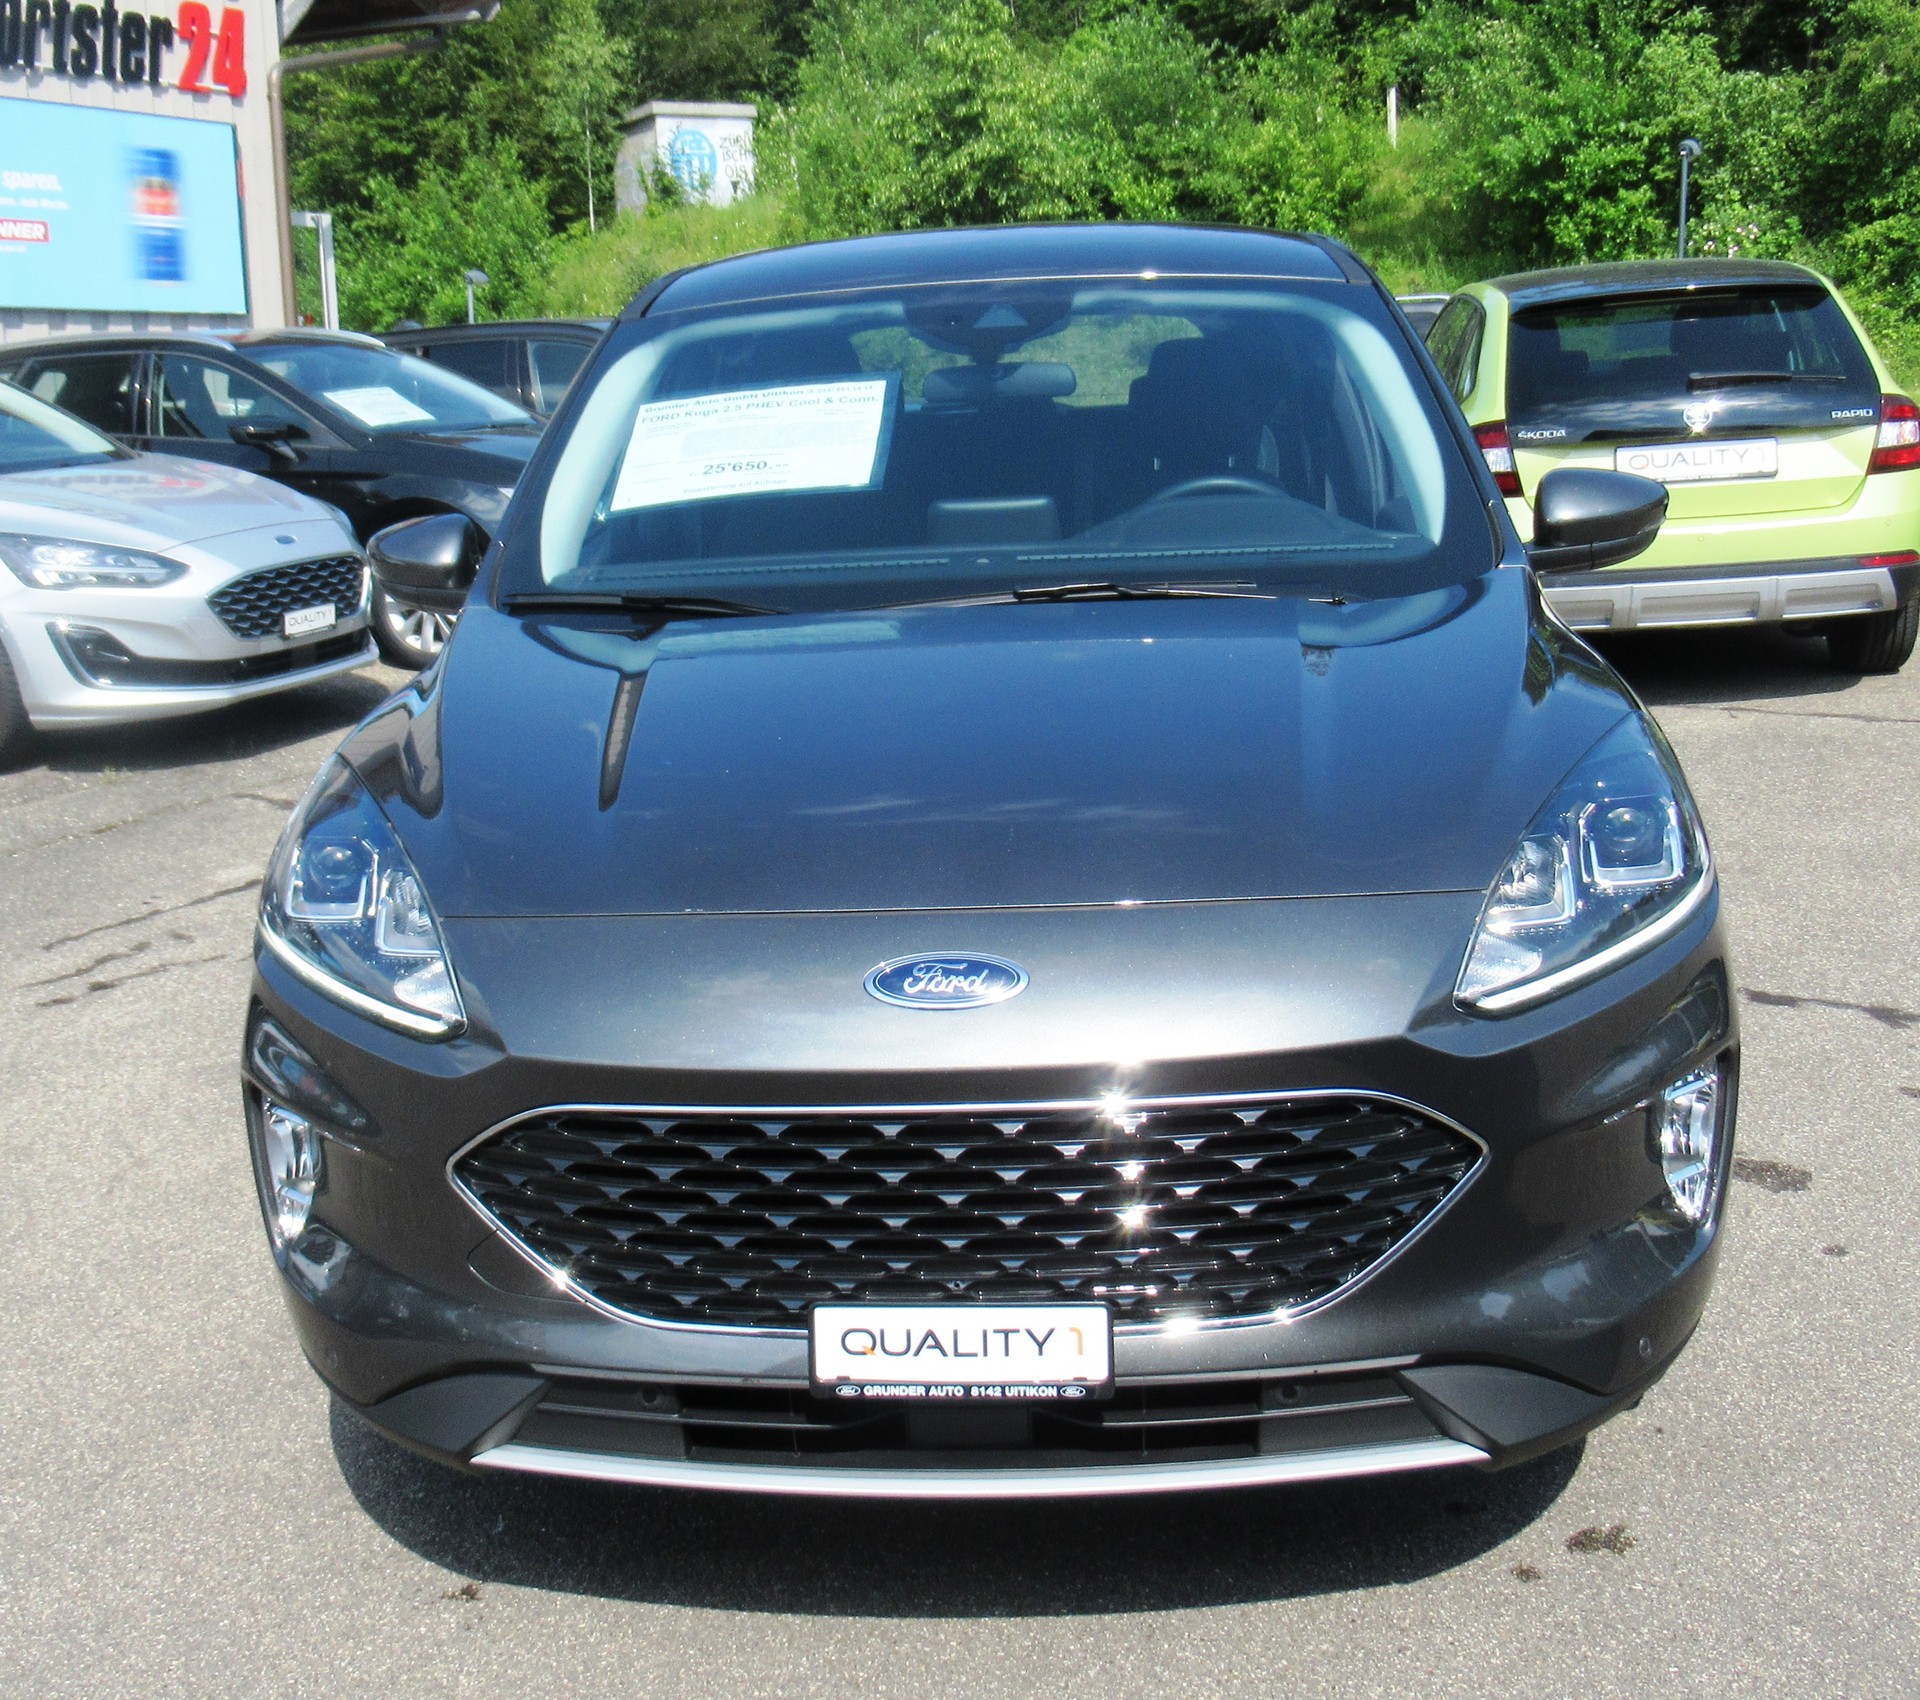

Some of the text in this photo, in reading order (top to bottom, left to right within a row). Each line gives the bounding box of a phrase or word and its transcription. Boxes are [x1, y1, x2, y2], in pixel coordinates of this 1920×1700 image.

[641, 412, 681, 425] FORD
[684, 406, 719, 418] Kuga
[722, 402, 743, 414] 2.5
[746, 398, 785, 412] PHEV
[789, 396, 820, 407] Cool
[824, 396, 834, 404] &
[1830, 407, 1874, 419] RAPID
[1628, 446, 1750, 471] QUALITY
[903, 962, 989, 994] Ford
[840, 1327, 1084, 1357] QUALITY 1
[863, 1384, 926, 1397] GRUNDER
[929, 1384, 964, 1396] AUTO
[970, 1384, 1002, 1397] 8142
[1004, 1384, 1058, 1397] UITIKON
